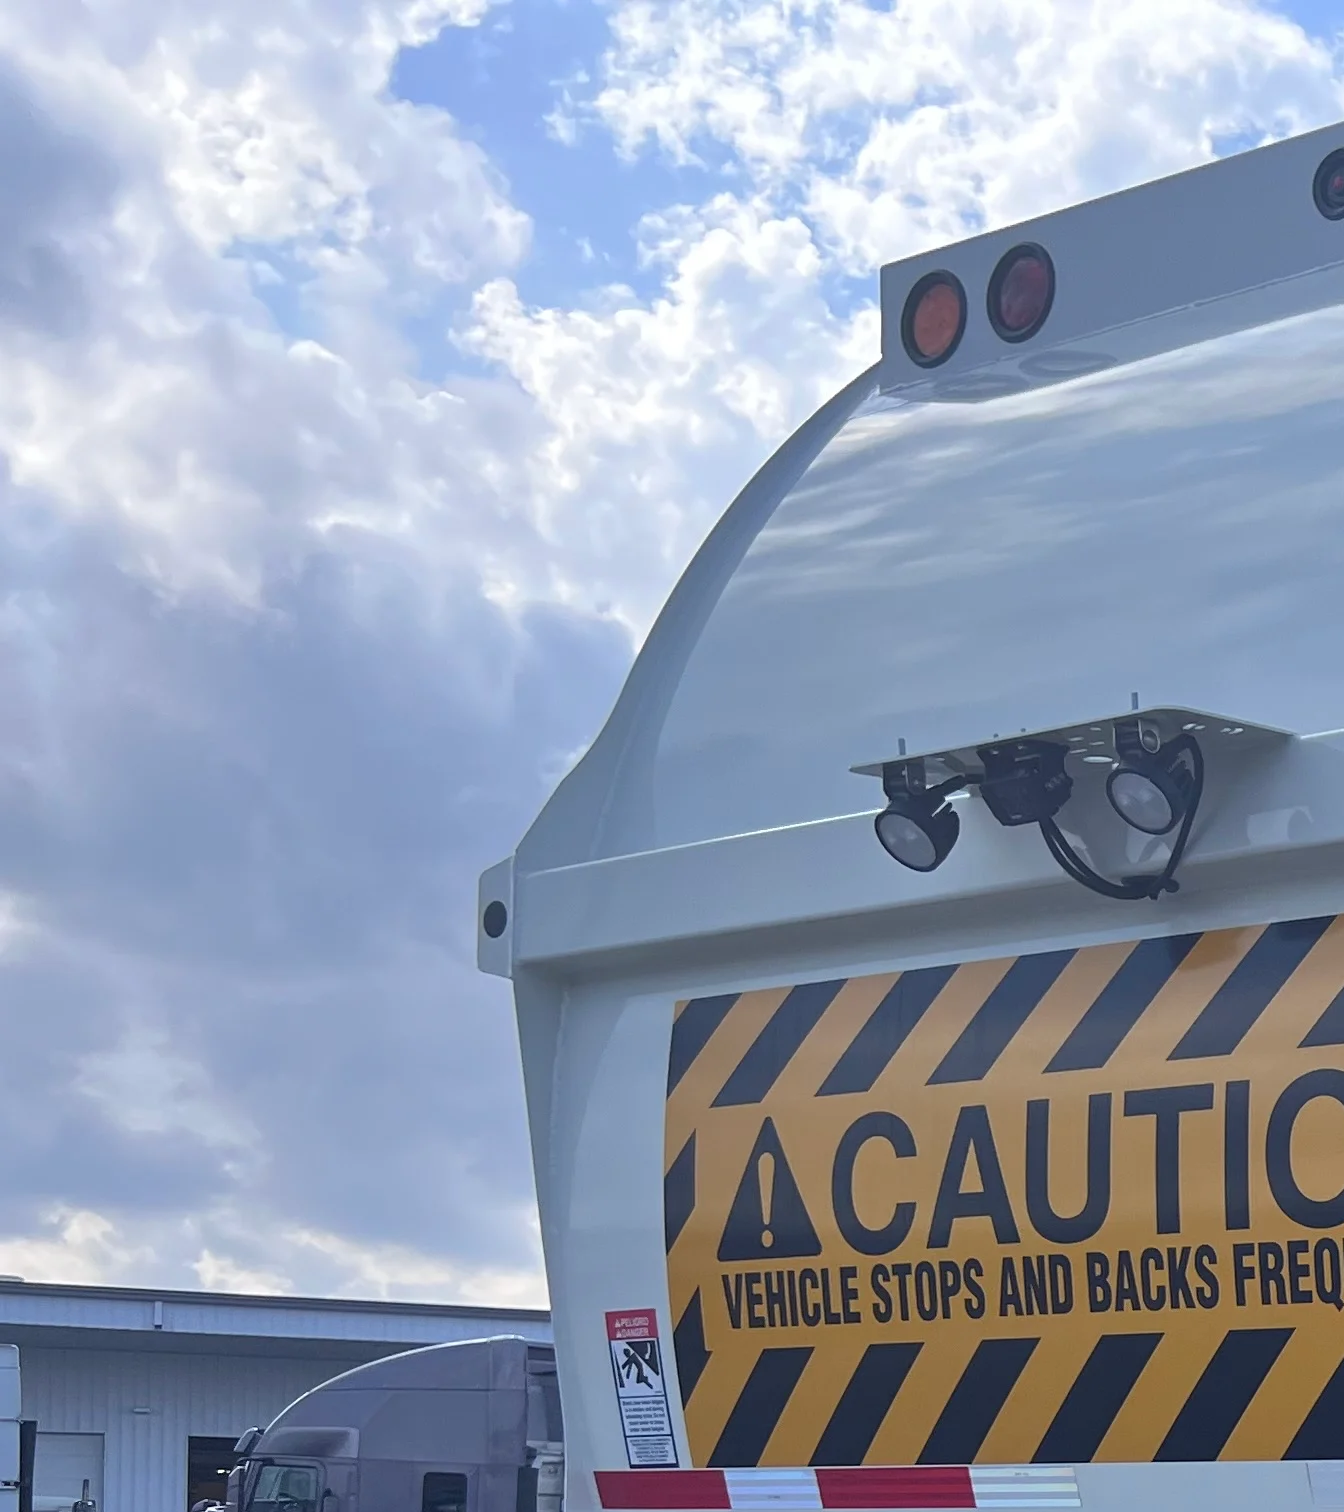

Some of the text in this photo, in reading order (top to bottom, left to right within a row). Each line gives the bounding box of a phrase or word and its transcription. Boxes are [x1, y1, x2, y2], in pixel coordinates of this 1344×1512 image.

[722, 1267, 861, 1332] VEHICLE
[872, 1256, 987, 1325] STOPS
[999, 1250, 1074, 1315] AND
[1087, 1243, 1220, 1311] BACKS
